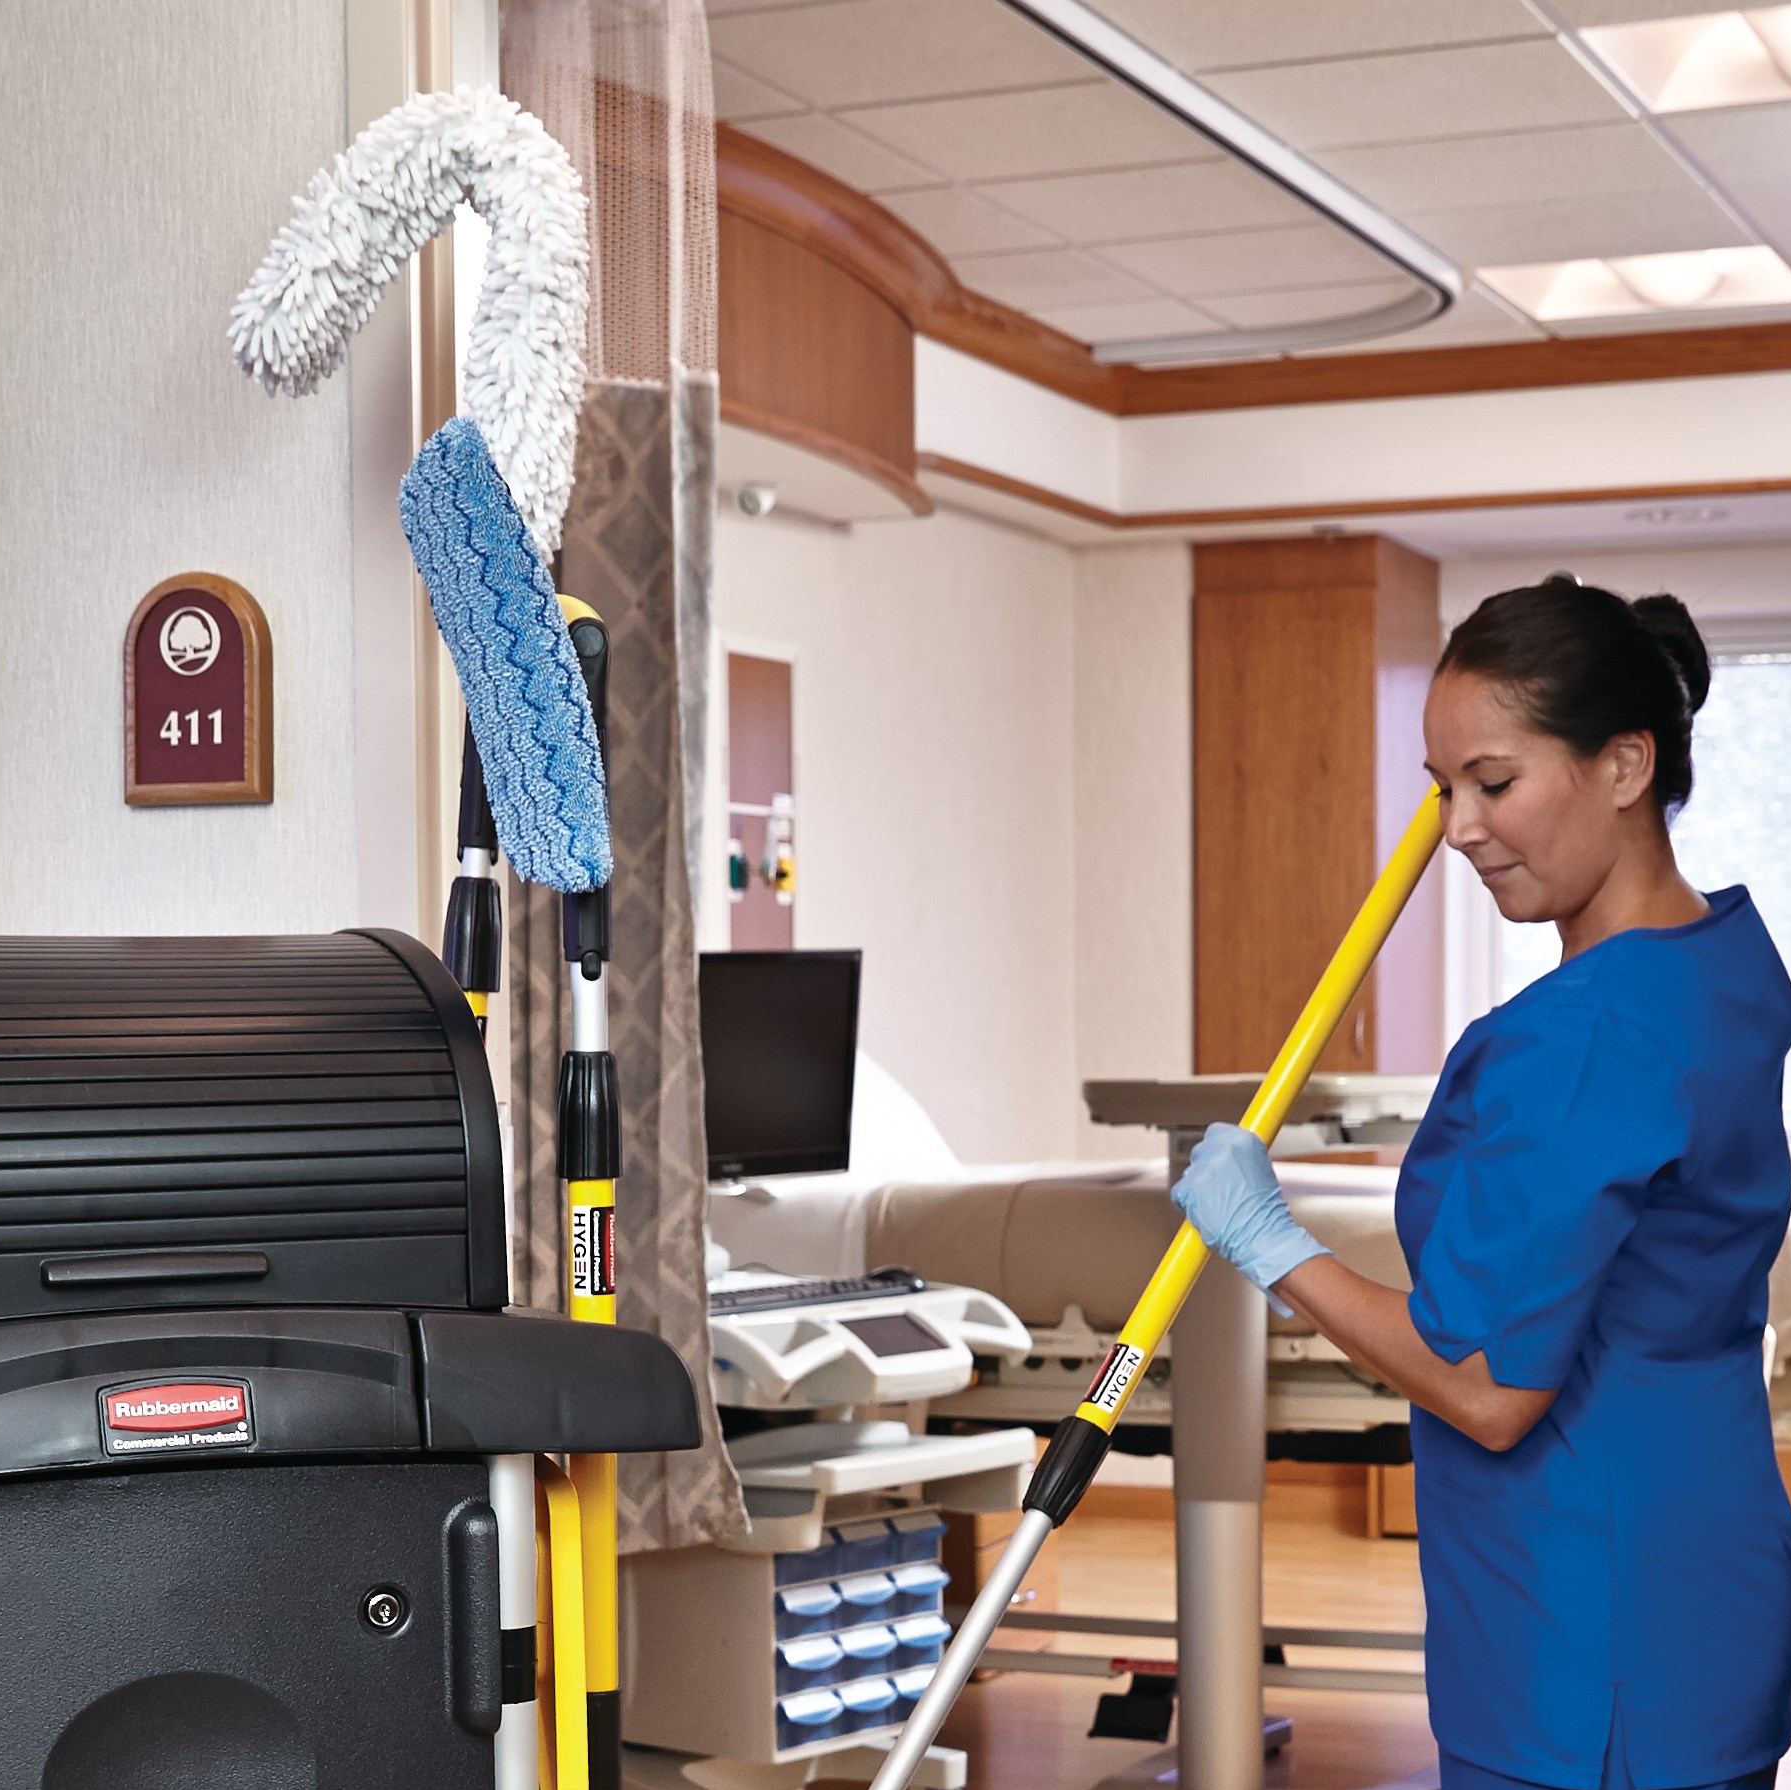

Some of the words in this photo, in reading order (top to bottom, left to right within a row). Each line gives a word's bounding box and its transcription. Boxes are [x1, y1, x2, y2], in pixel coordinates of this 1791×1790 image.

[159, 709, 222, 746] 411
[573, 1213, 587, 1290] HYGEN
[1103, 1352, 1140, 1408] HYGEN
[114, 1395, 239, 1418] Rubbermaid
[112, 1434, 190, 1450] Commercial
[192, 1430, 249, 1445] Products
